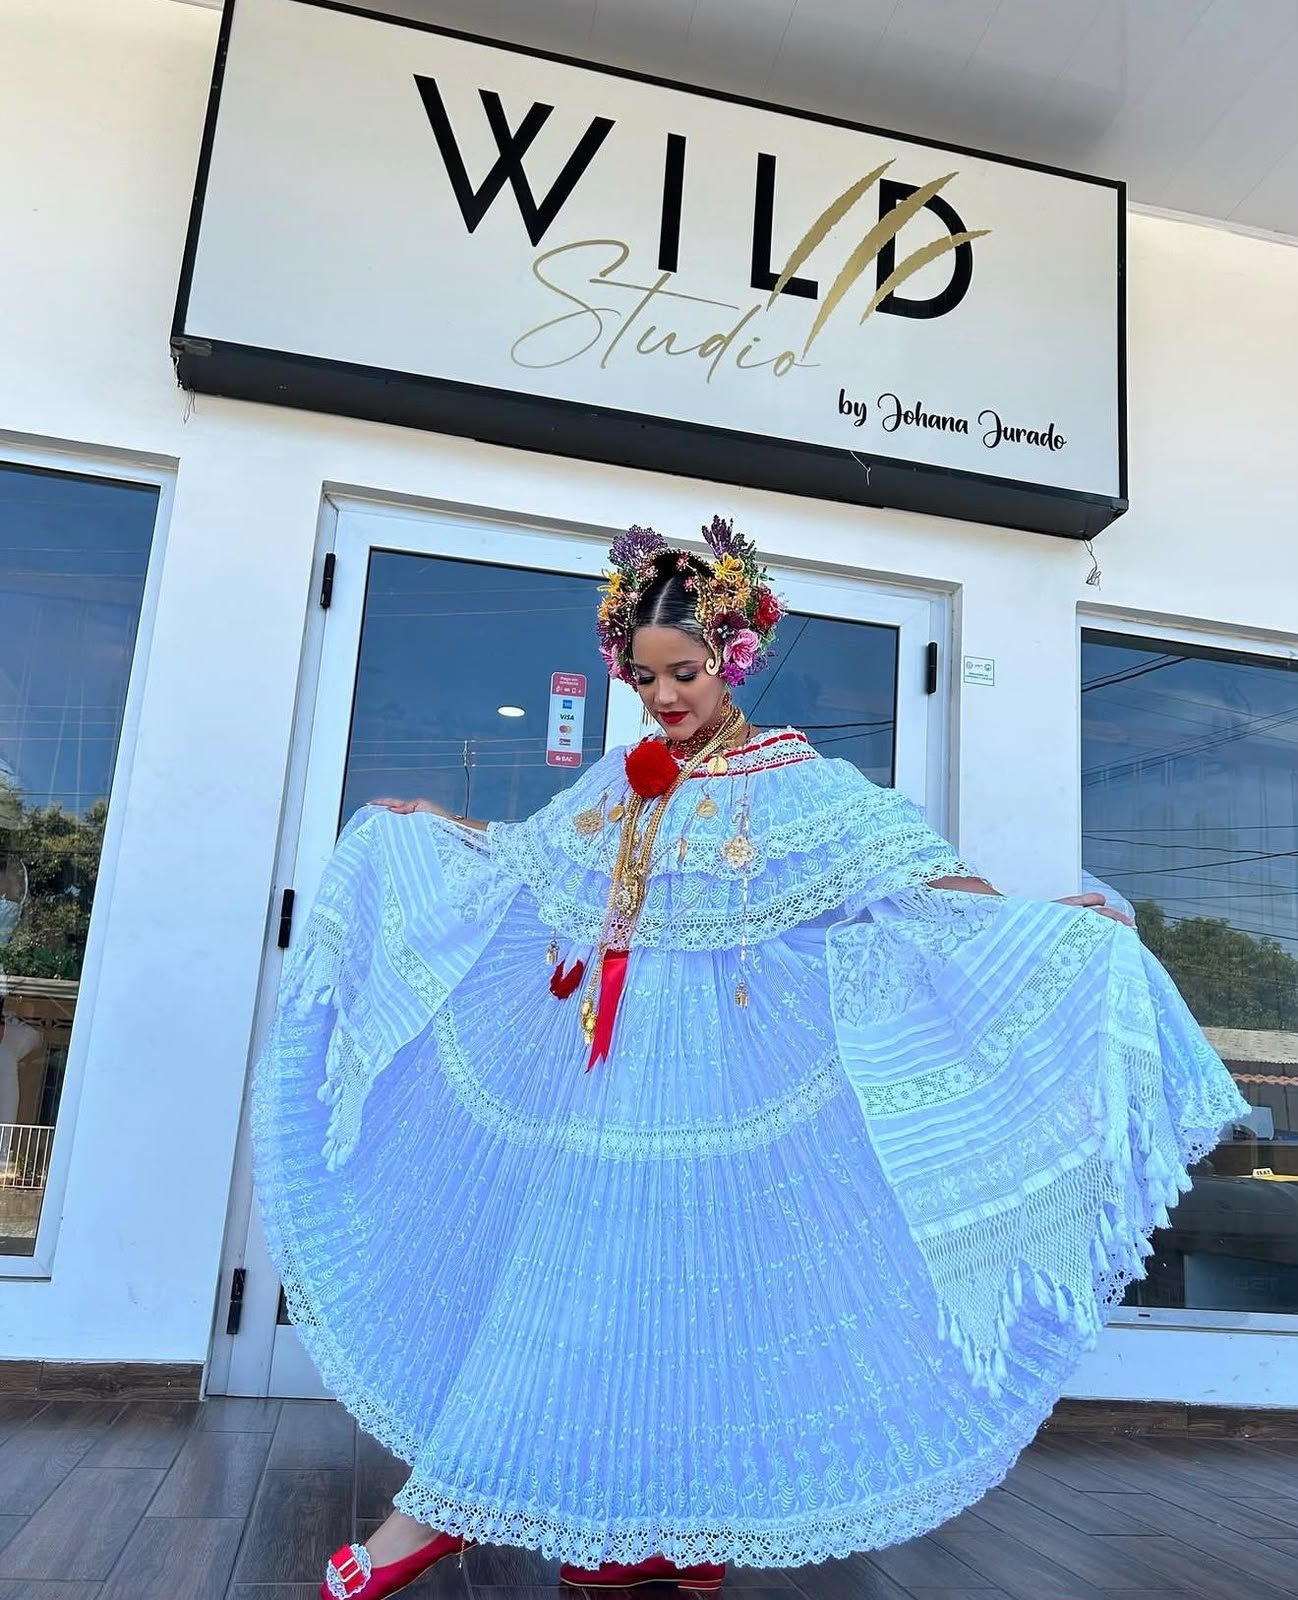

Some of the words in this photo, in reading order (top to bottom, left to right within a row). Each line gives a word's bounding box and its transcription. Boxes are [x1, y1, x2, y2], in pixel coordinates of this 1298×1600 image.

[413, 74, 974, 319] WILD
[511, 239, 820, 383] Studio
[838, 388, 868, 427] by
[877, 393, 969, 433] Johana
[978, 409, 1067, 452] Jurado
